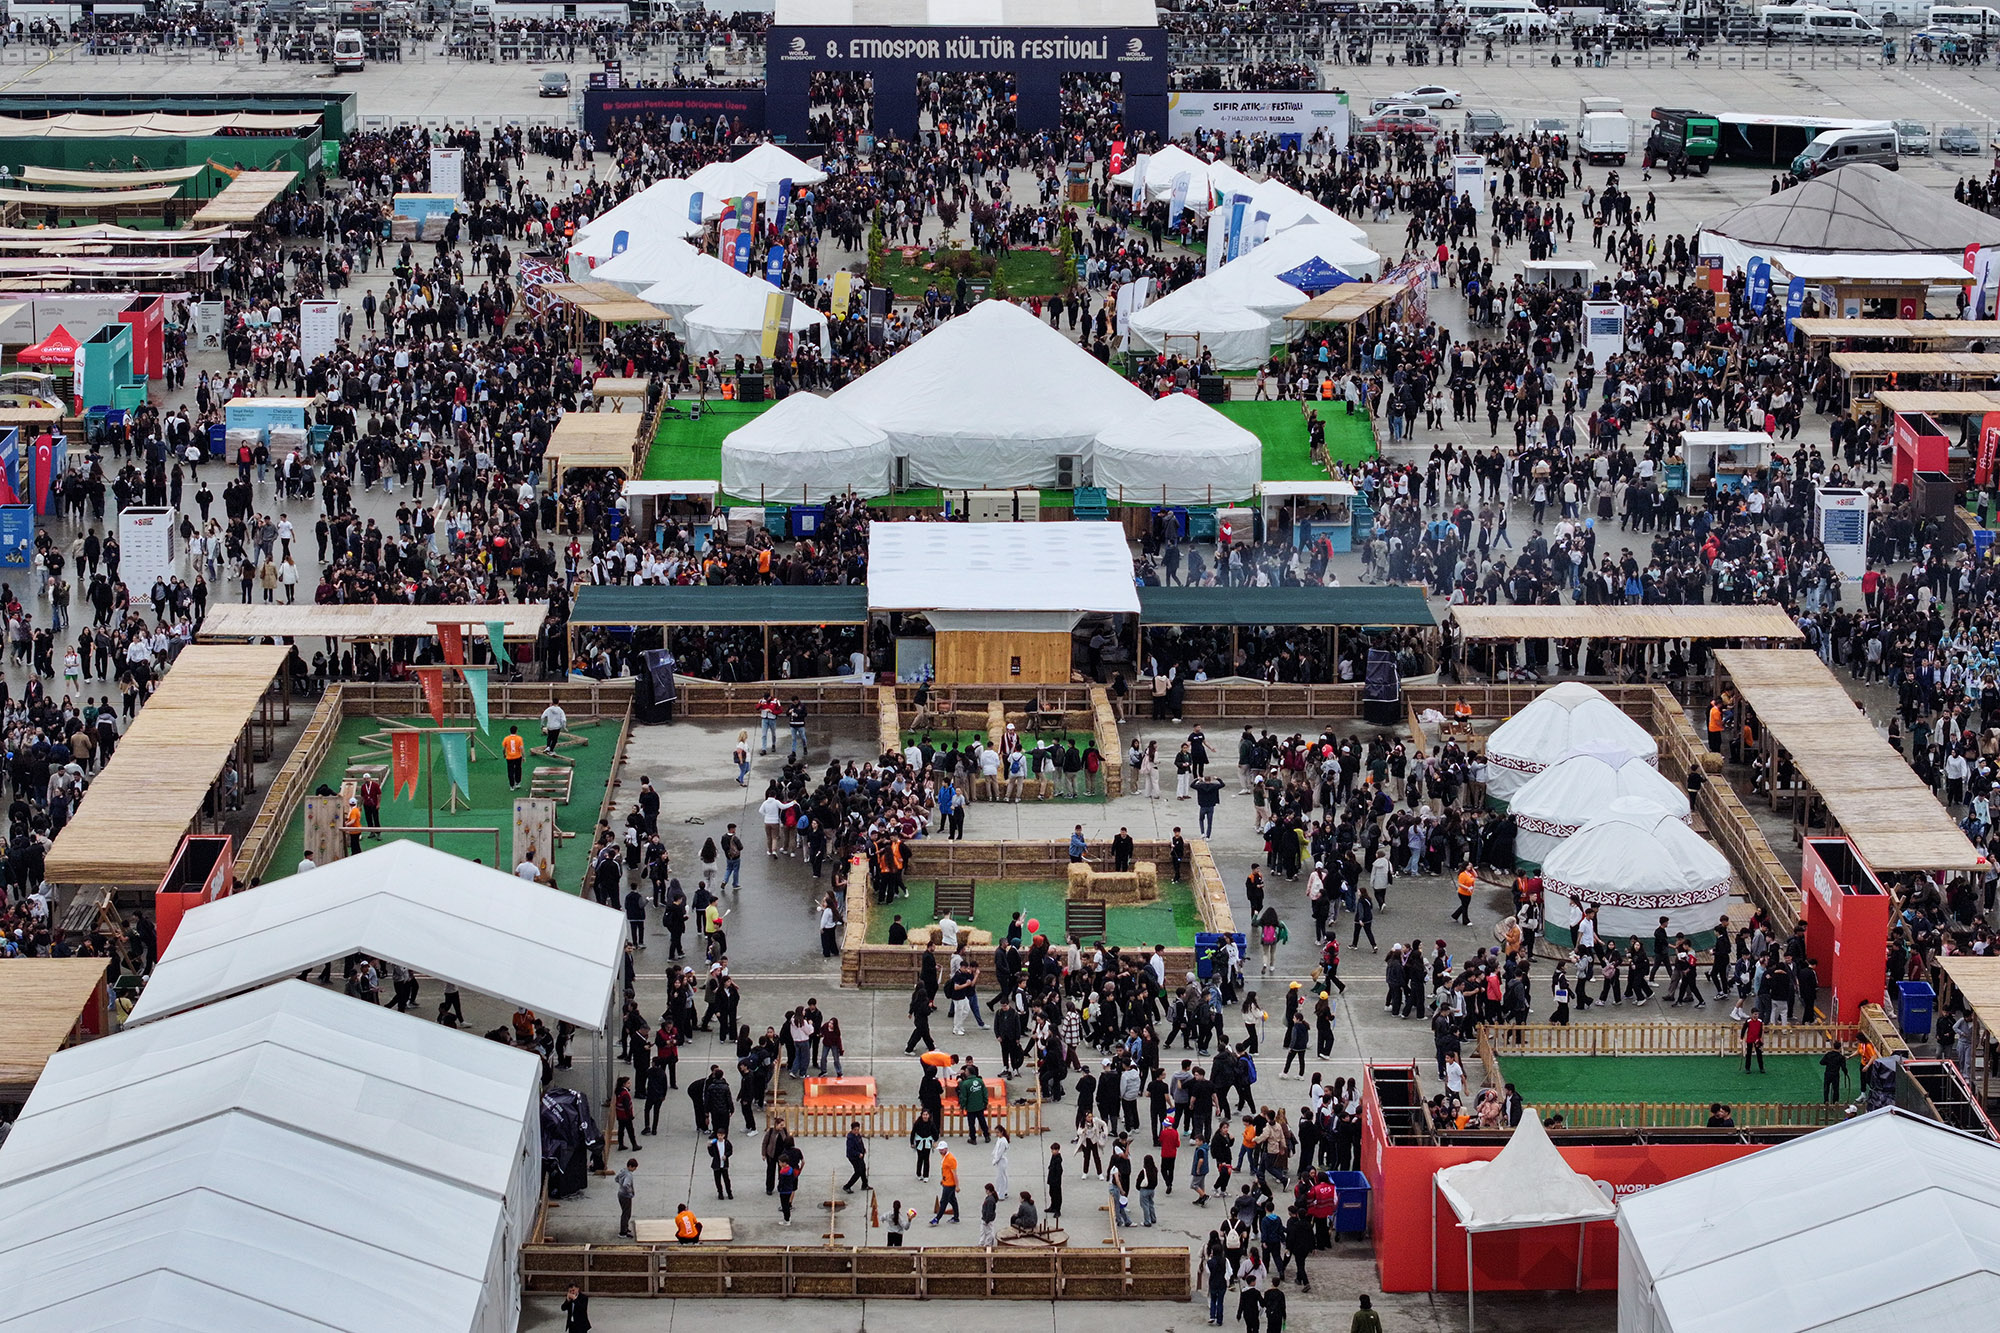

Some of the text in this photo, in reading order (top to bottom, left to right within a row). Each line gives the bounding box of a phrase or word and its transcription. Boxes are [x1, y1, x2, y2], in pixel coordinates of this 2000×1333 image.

[826, 35, 1108, 59] 8. ETNOSPOR KÜLTÜR FESTİVALİ
[645, 100, 684, 108] Festivalde
[685, 100, 723, 109] Görüşmek
[725, 100, 747, 110] Üzere
[1212, 102, 1239, 111] SIFIR
[1240, 102, 1260, 111] ATIK
